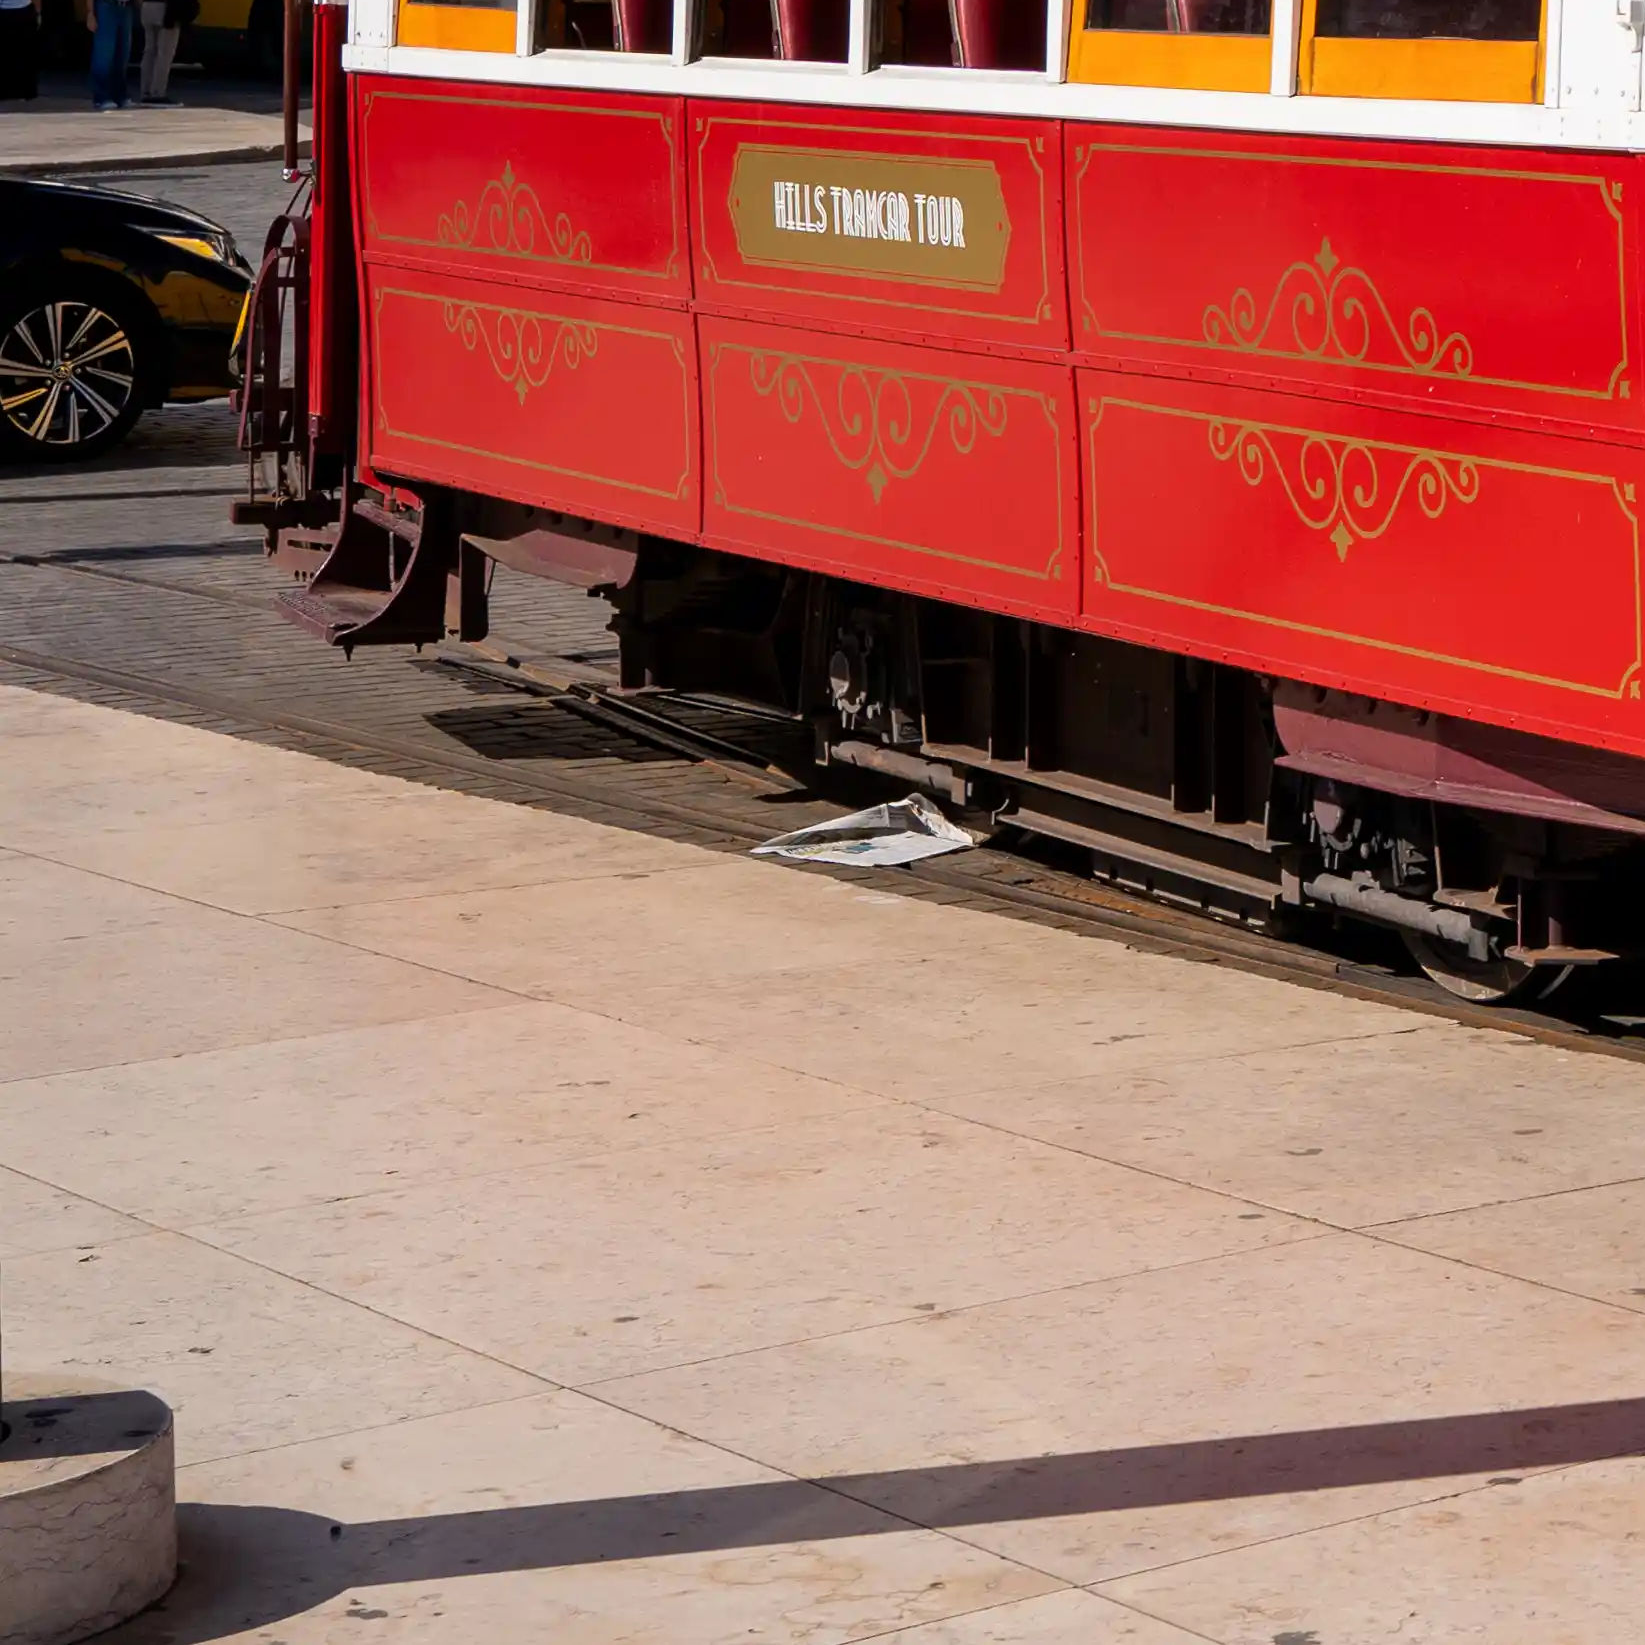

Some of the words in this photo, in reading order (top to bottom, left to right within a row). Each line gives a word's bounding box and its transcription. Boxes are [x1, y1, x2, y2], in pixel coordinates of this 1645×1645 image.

[773, 181, 827, 234] HILLS
[830, 186, 912, 242] TRAMCAR
[914, 193, 966, 248] TOUR
